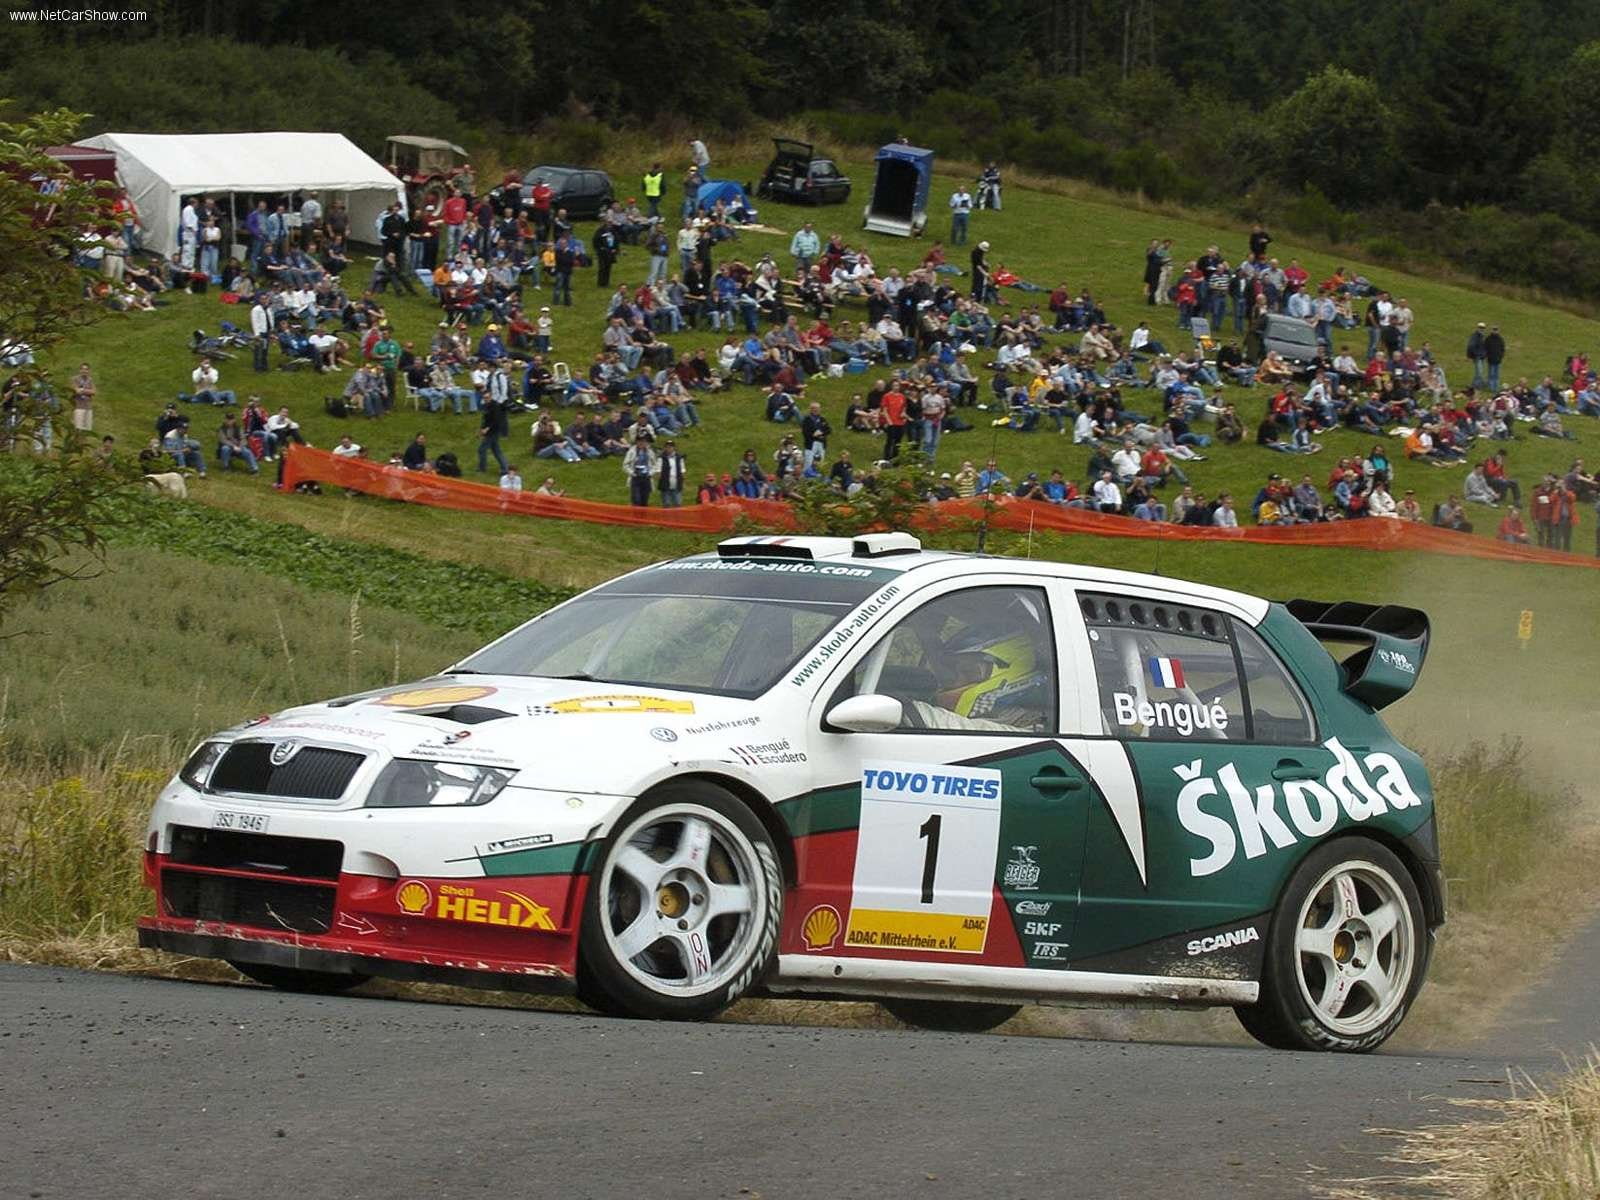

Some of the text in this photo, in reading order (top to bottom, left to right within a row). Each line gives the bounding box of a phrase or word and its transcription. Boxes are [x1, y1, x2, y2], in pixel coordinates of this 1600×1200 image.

[791, 585, 900, 687] www.skoda-auto.com
[1113, 692, 1228, 736] Bengué
[746, 738, 790, 754] Bengué
[757, 752, 807, 764] Escudero
[864, 770, 1000, 799] TOYO TIRES
[1172, 736, 1422, 877] Škoda
[919, 814, 942, 904] 1
[439, 885, 475, 897] Shell
[437, 891, 557, 930] HELIX
[962, 918, 985, 931] ADAC
[1024, 921, 1062, 937] SKF
[848, 930, 957, 949] ADAC Mittelrhein e.V.
[1033, 942, 1060, 957] TRS
[1187, 926, 1260, 956] SCANIA
